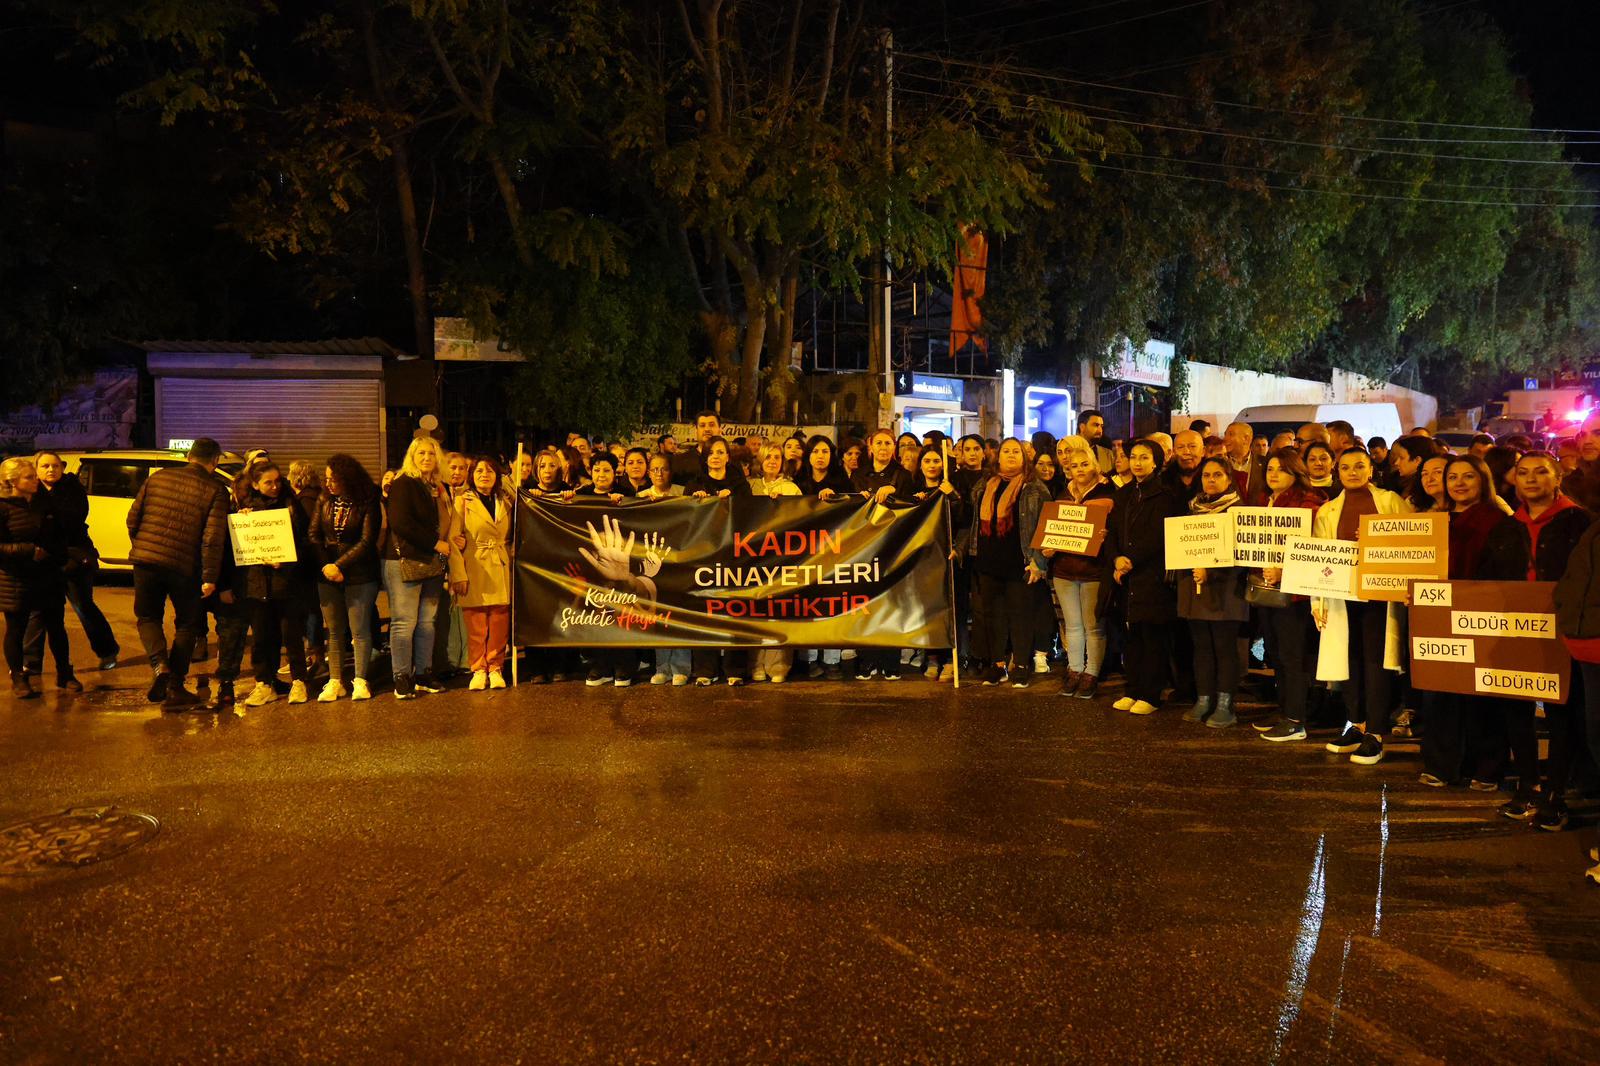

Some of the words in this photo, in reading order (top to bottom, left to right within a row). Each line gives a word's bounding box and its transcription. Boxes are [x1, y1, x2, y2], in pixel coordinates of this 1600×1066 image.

[1584, 371, 1600, 379] YIL
[912, 382, 953, 395] ankamatik
[773, 425, 802, 437] Key
[1062, 509, 1083, 518] KADIN
[1237, 512, 1257, 527] ÖLEN
[1259, 512, 1272, 527] BİR
[1275, 515, 1301, 528] KADIN
[1049, 522, 1090, 534] CİNAYETLERİ
[1184, 522, 1216, 531] İSTANBUL
[1372, 521, 1430, 533] KAZANILMIŞ
[734, 529, 841, 557] KADIN
[1046, 537, 1082, 548] POLİTİKTİR
[1180, 532, 1220, 543] SÖZLEŞMESİ
[1236, 529, 1257, 544] ÖLEN
[1259, 529, 1272, 545] BİR
[1294, 542, 1337, 553] KADINLAR
[1340, 544, 1359, 555] ARTI
[1368, 549, 1435, 560] HAKLARIMIZDAN
[1252, 548, 1266, 563] BİR
[1290, 553, 1359, 567] SUSMAYACAKLA
[694, 557, 880, 587] CİNAYETLERİ
[1366, 576, 1413, 589] VAZGEÇMİ
[585, 588, 638, 608] Kadına
[1419, 588, 1446, 603] AŞK
[705, 591, 871, 618] POLİTİKTİR
[560, 607, 615, 631] Şiddete
[617, 606, 671, 631] Hayır!
[1458, 614, 1509, 631] ÖLDÜR
[1515, 619, 1549, 632] MEZ
[1419, 641, 1467, 656] ŞİDDET
